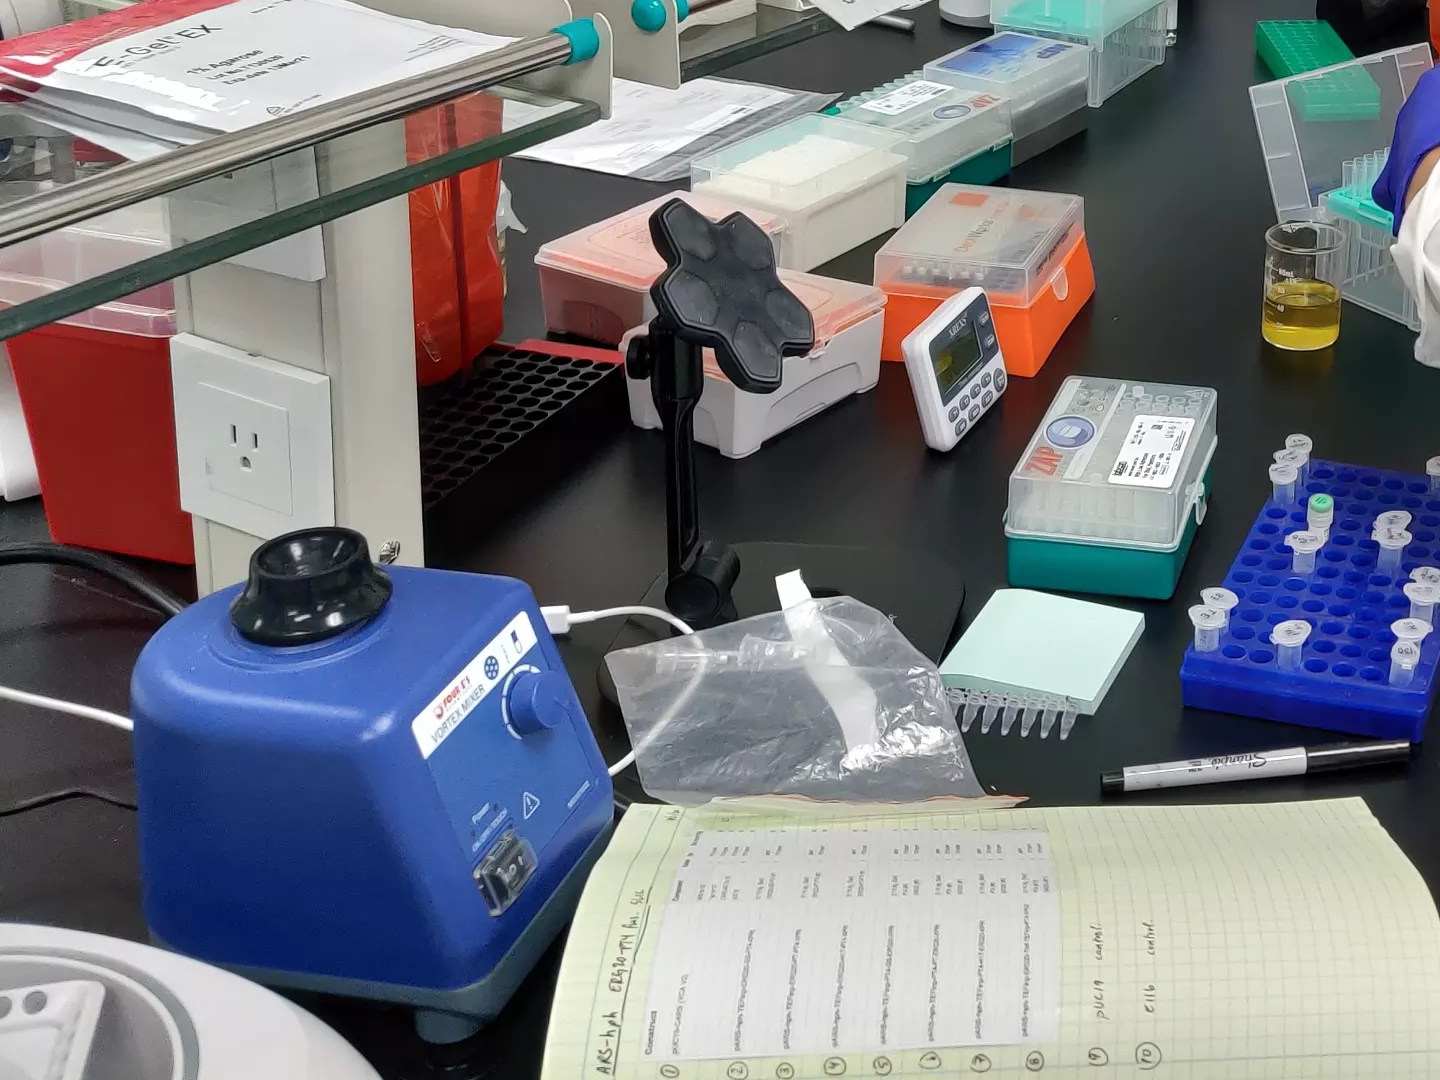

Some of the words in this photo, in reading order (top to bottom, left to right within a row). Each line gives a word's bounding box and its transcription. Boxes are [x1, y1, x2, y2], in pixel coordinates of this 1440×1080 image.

[174, 24, 224, 39] EX
[208, 49, 264, 69] Agarose
[1024, 446, 1063, 476] ZAP
[431, 709, 463, 743] VORTEX
[461, 684, 486, 713] MIXER
[443, 686, 460, 708] FOUR
[1093, 980, 1110, 1020] pUC19
[596, 1011, 620, 1075] ARS-hph
[644, 1009, 658, 1055] Construct
